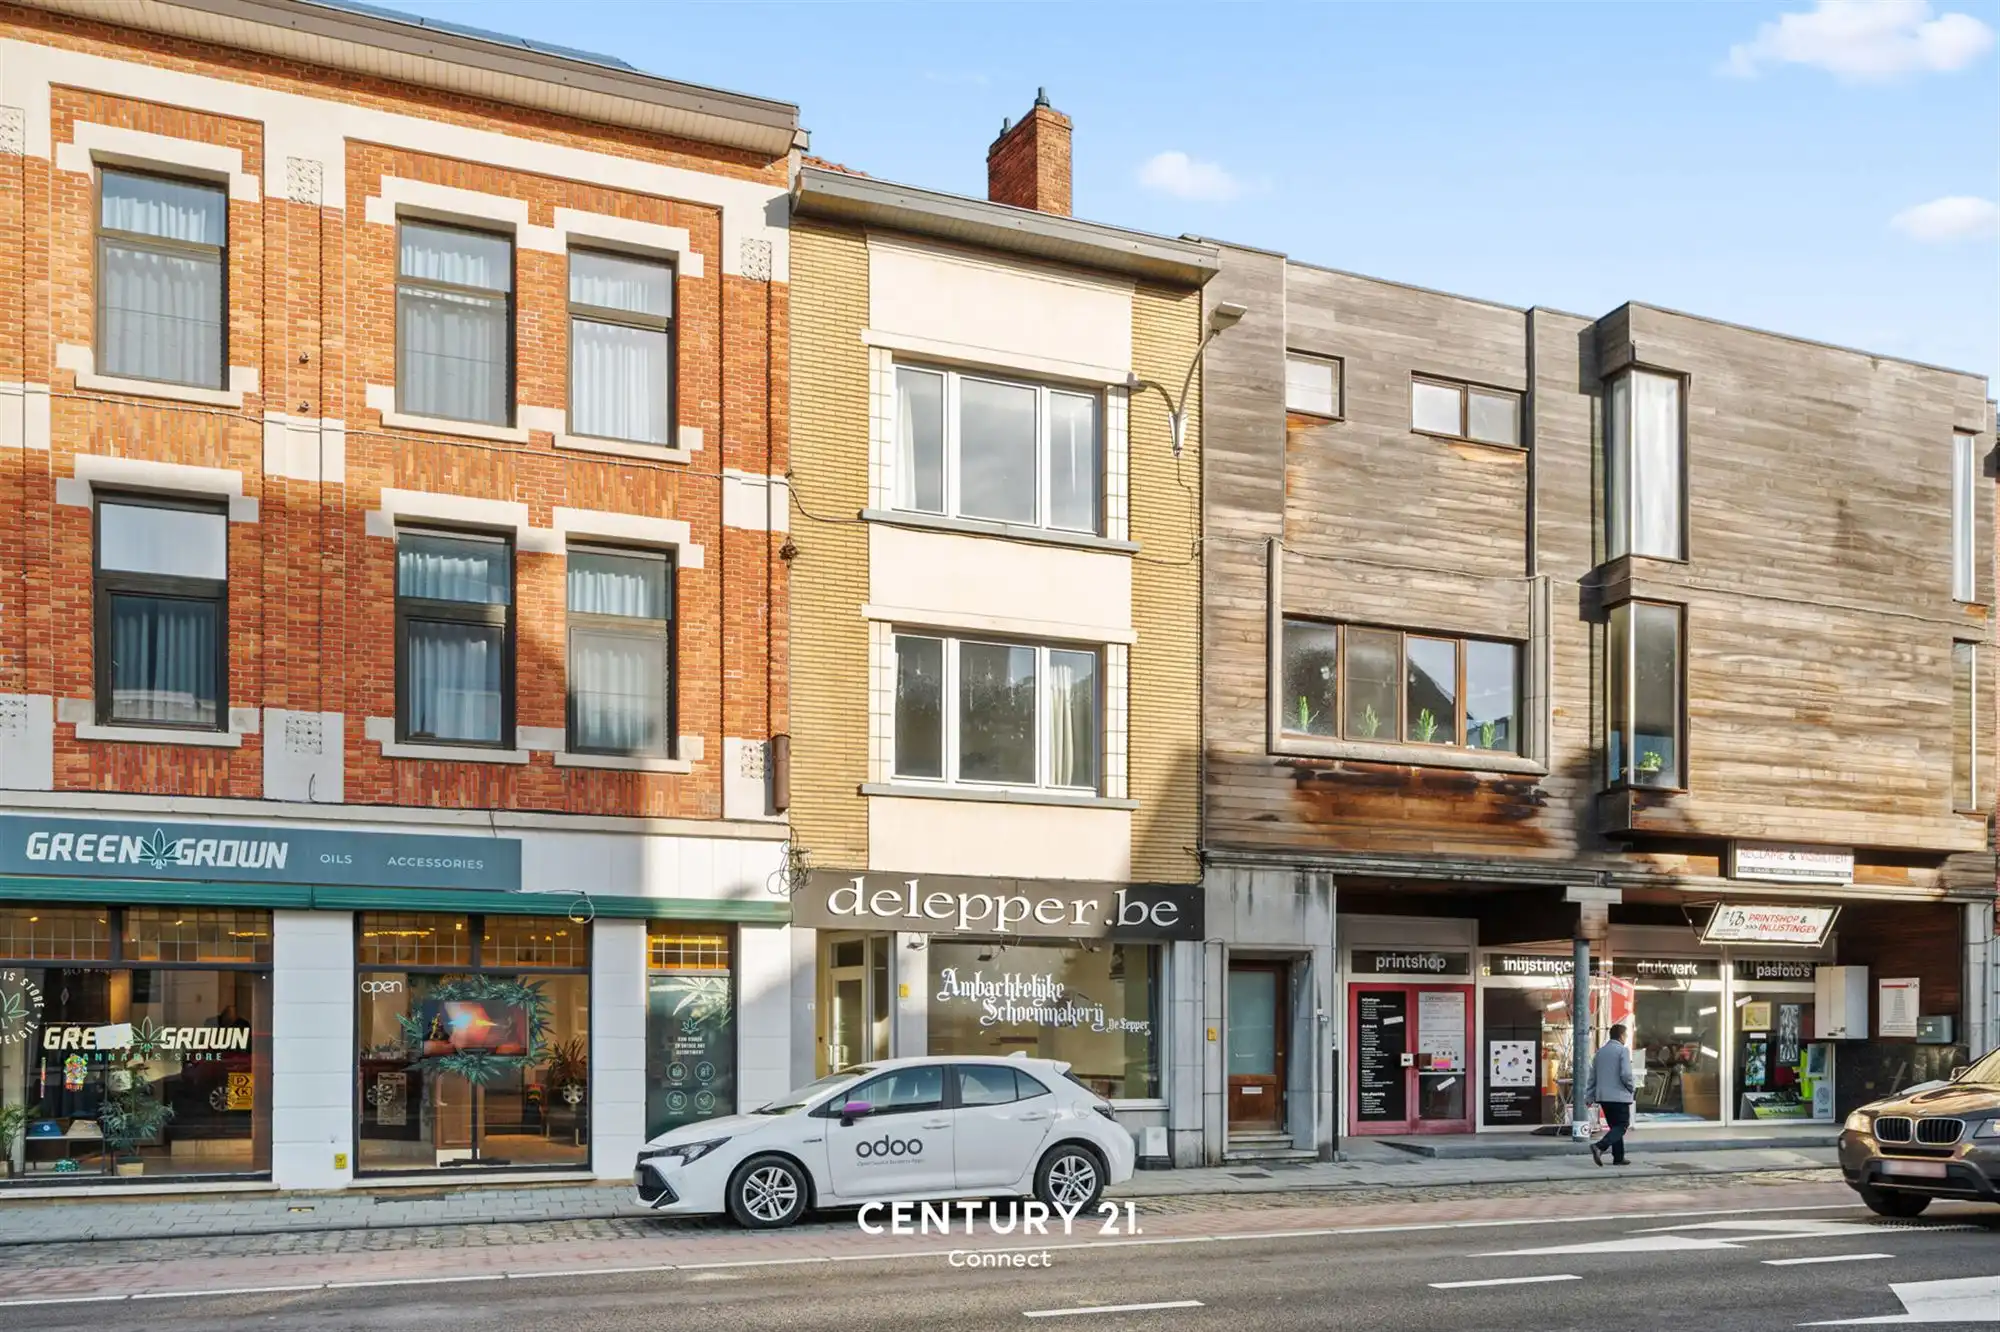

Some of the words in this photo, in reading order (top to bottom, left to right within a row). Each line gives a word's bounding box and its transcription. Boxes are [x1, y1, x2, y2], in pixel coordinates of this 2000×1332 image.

[26, 832, 143, 864] GREEN
[175, 838, 288, 869] GROWN
[320, 853, 352, 864] OILS
[387, 856, 484, 870] ACCESSORIES
[827, 876, 1179, 932] delepper.be
[1747, 911, 1800, 924] PRINTSHOP
[1799, 915, 1807, 924] &
[1376, 953, 1446, 971] printshop
[1636, 960, 1698, 977] drukwerk
[1756, 961, 1811, 979] pasfoto's
[20, 978, 45, 1008] STORE
[361, 981, 402, 1000] open
[43, 1027, 131, 1050] GRE
[160, 1027, 250, 1050] GROWN
[70, 1052, 161, 1062] ANNABIS
[175, 1052, 222, 1062] STORE
[856, 1134, 923, 1158] odoo
